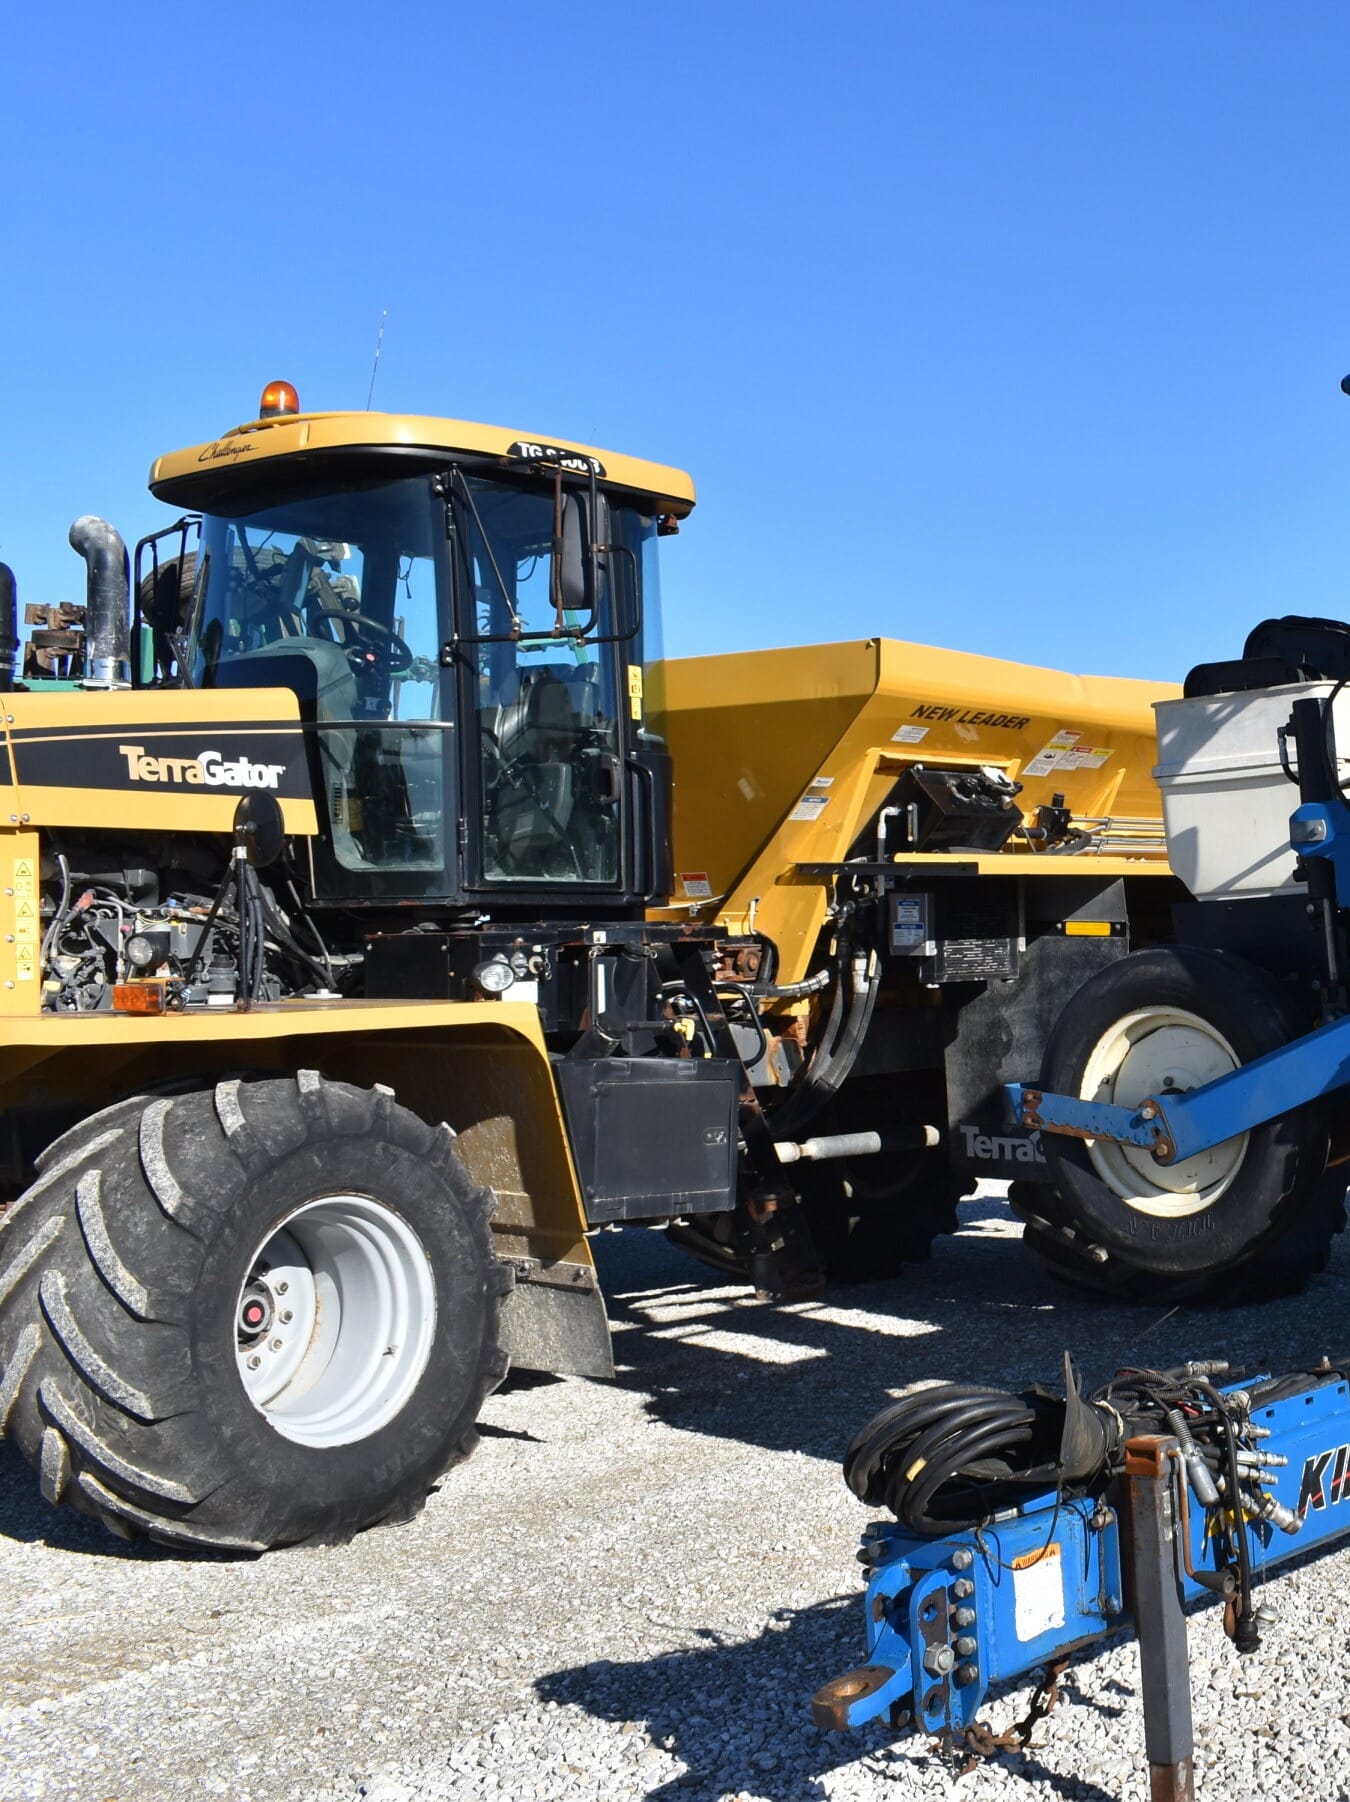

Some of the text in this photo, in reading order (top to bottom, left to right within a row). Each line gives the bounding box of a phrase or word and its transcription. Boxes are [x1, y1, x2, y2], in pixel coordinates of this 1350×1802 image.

[517, 441, 543, 458] TG
[910, 704, 1032, 730] NEW LEADER
[119, 745, 286, 789] TerraGator
